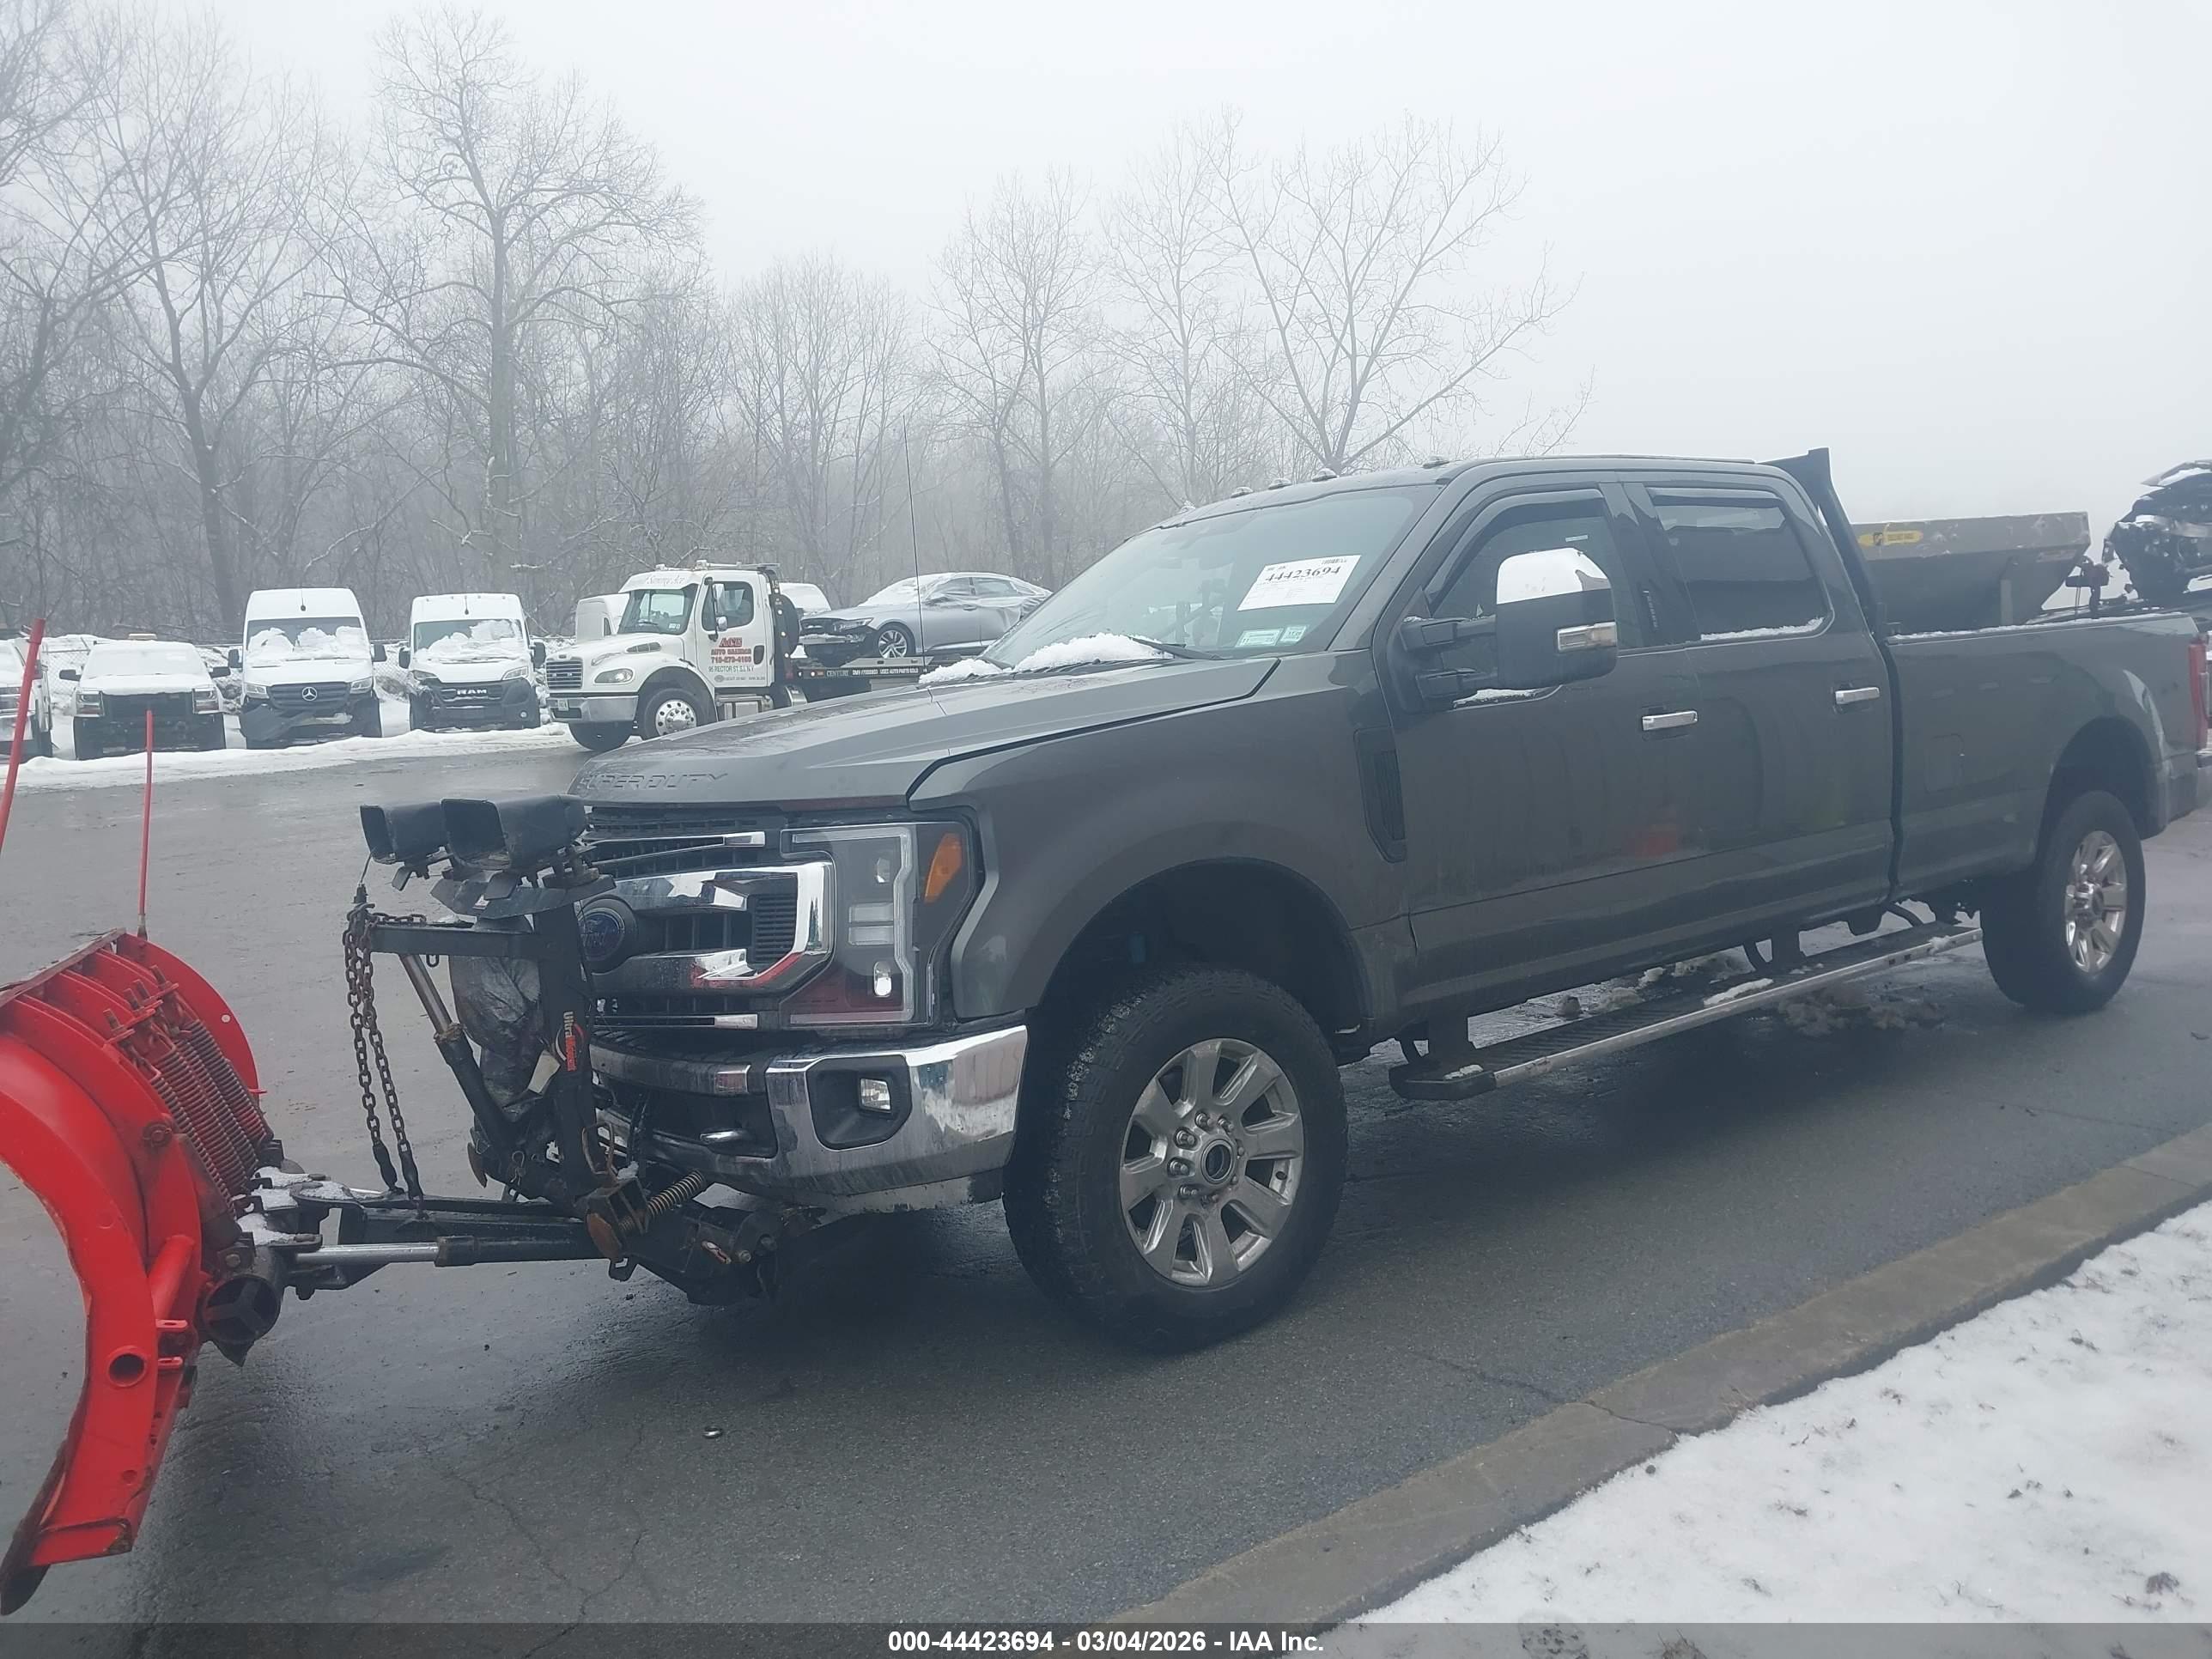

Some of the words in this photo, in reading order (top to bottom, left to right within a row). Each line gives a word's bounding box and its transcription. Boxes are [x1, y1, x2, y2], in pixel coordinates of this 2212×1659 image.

[1266, 566, 1341, 582] 44423694
[719, 637, 742, 647] ACE
[577, 774, 644, 790] SUPER
[645, 772, 728, 790] DUTY
